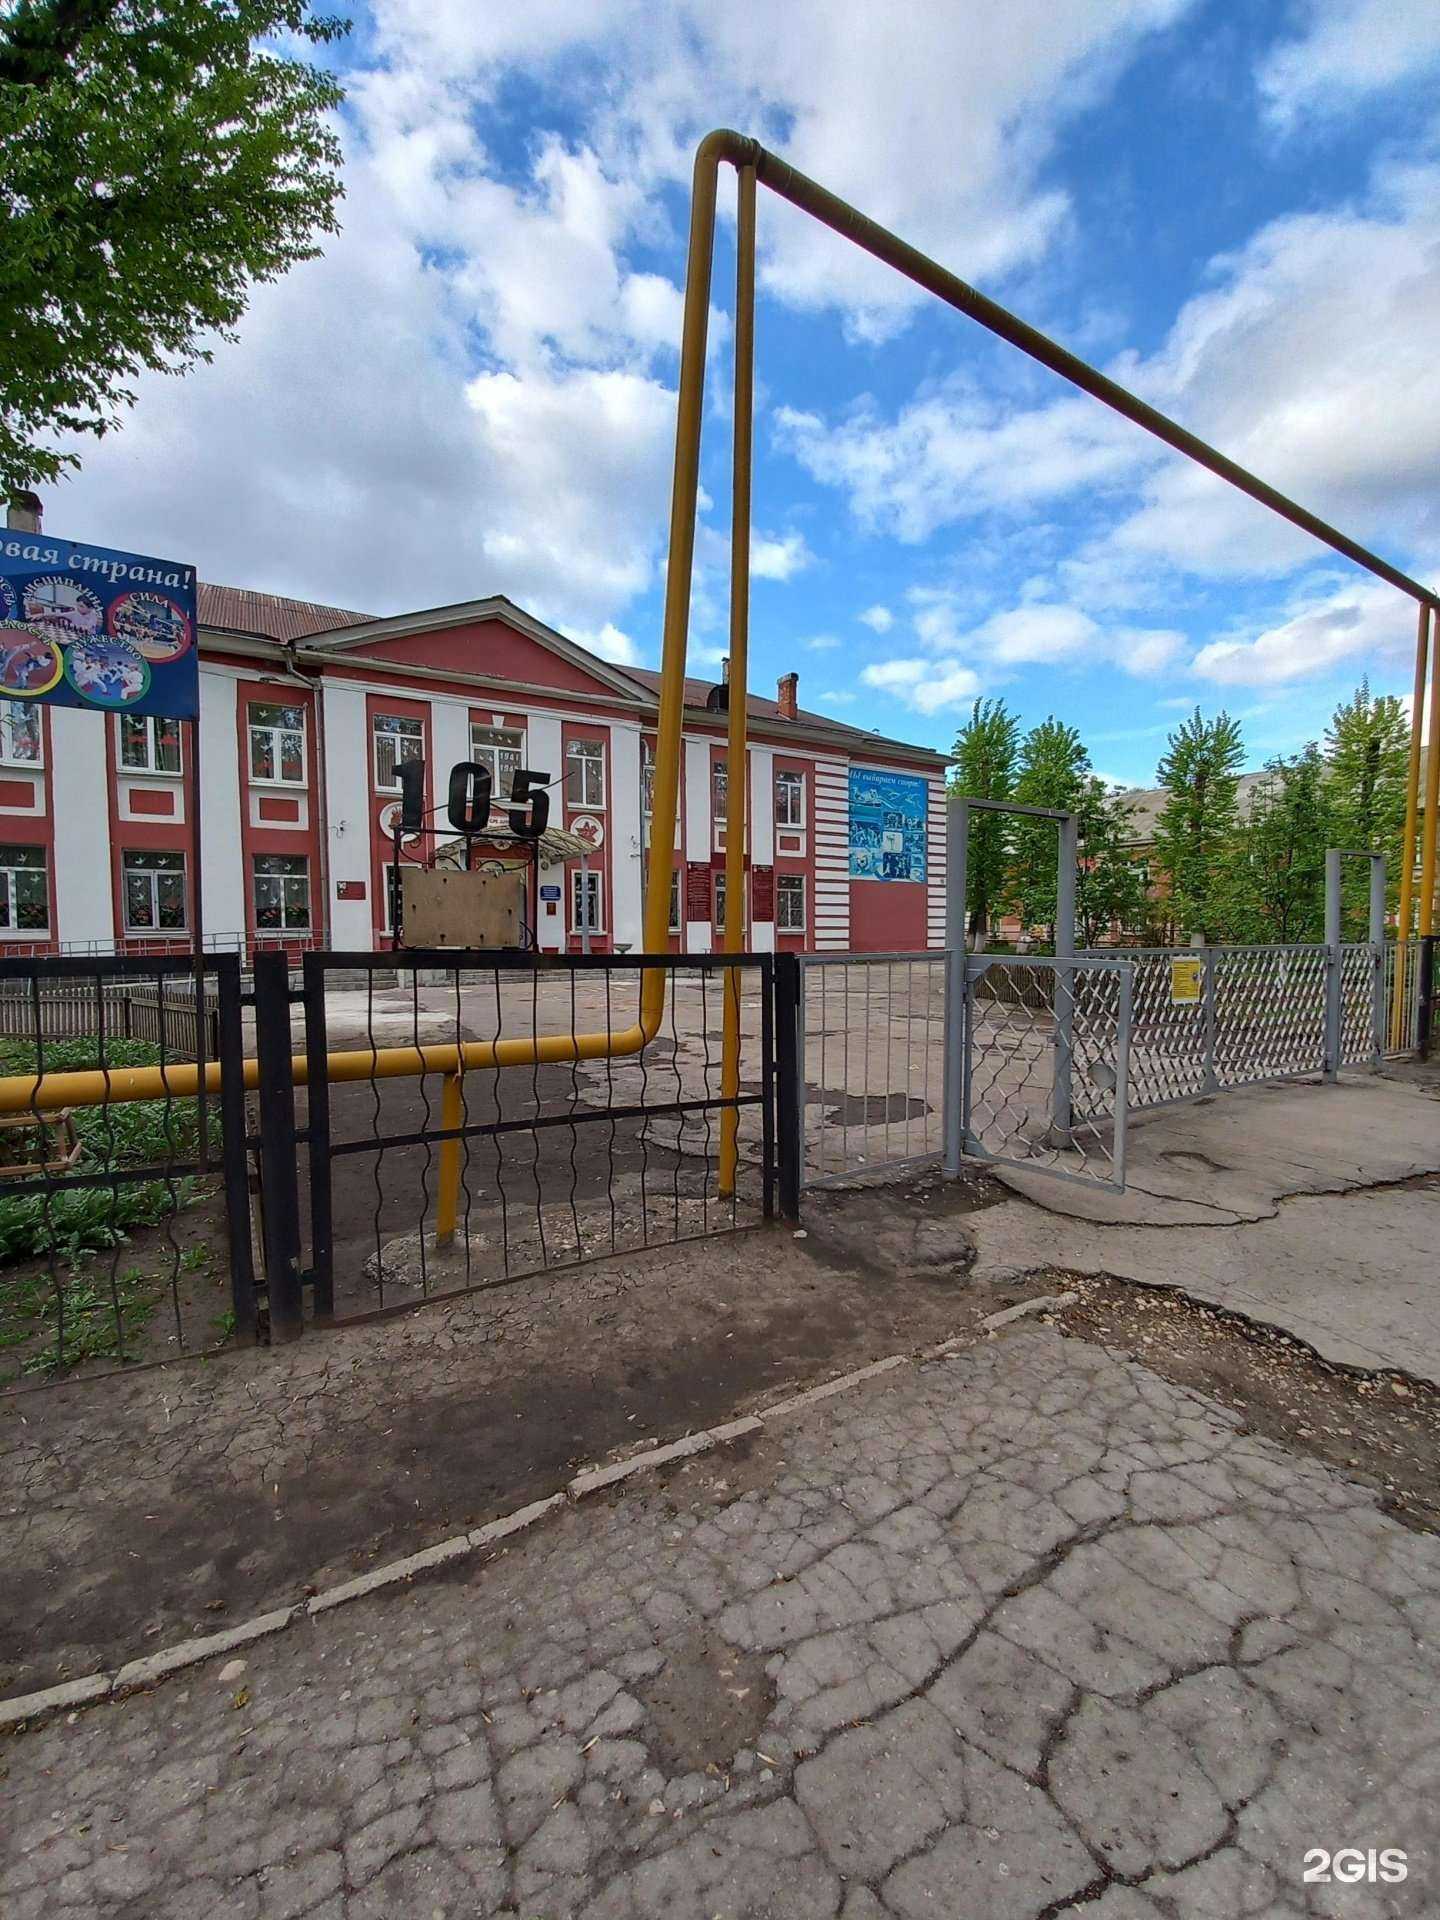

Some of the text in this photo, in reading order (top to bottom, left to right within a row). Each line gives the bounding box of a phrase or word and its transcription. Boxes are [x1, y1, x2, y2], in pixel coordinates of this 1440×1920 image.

[68, 553, 190, 590] страна!
[129, 592, 169, 608] СИЛА
[71, 634, 142, 660] МУЖЕСТВО
[392, 760, 551, 837] 105
